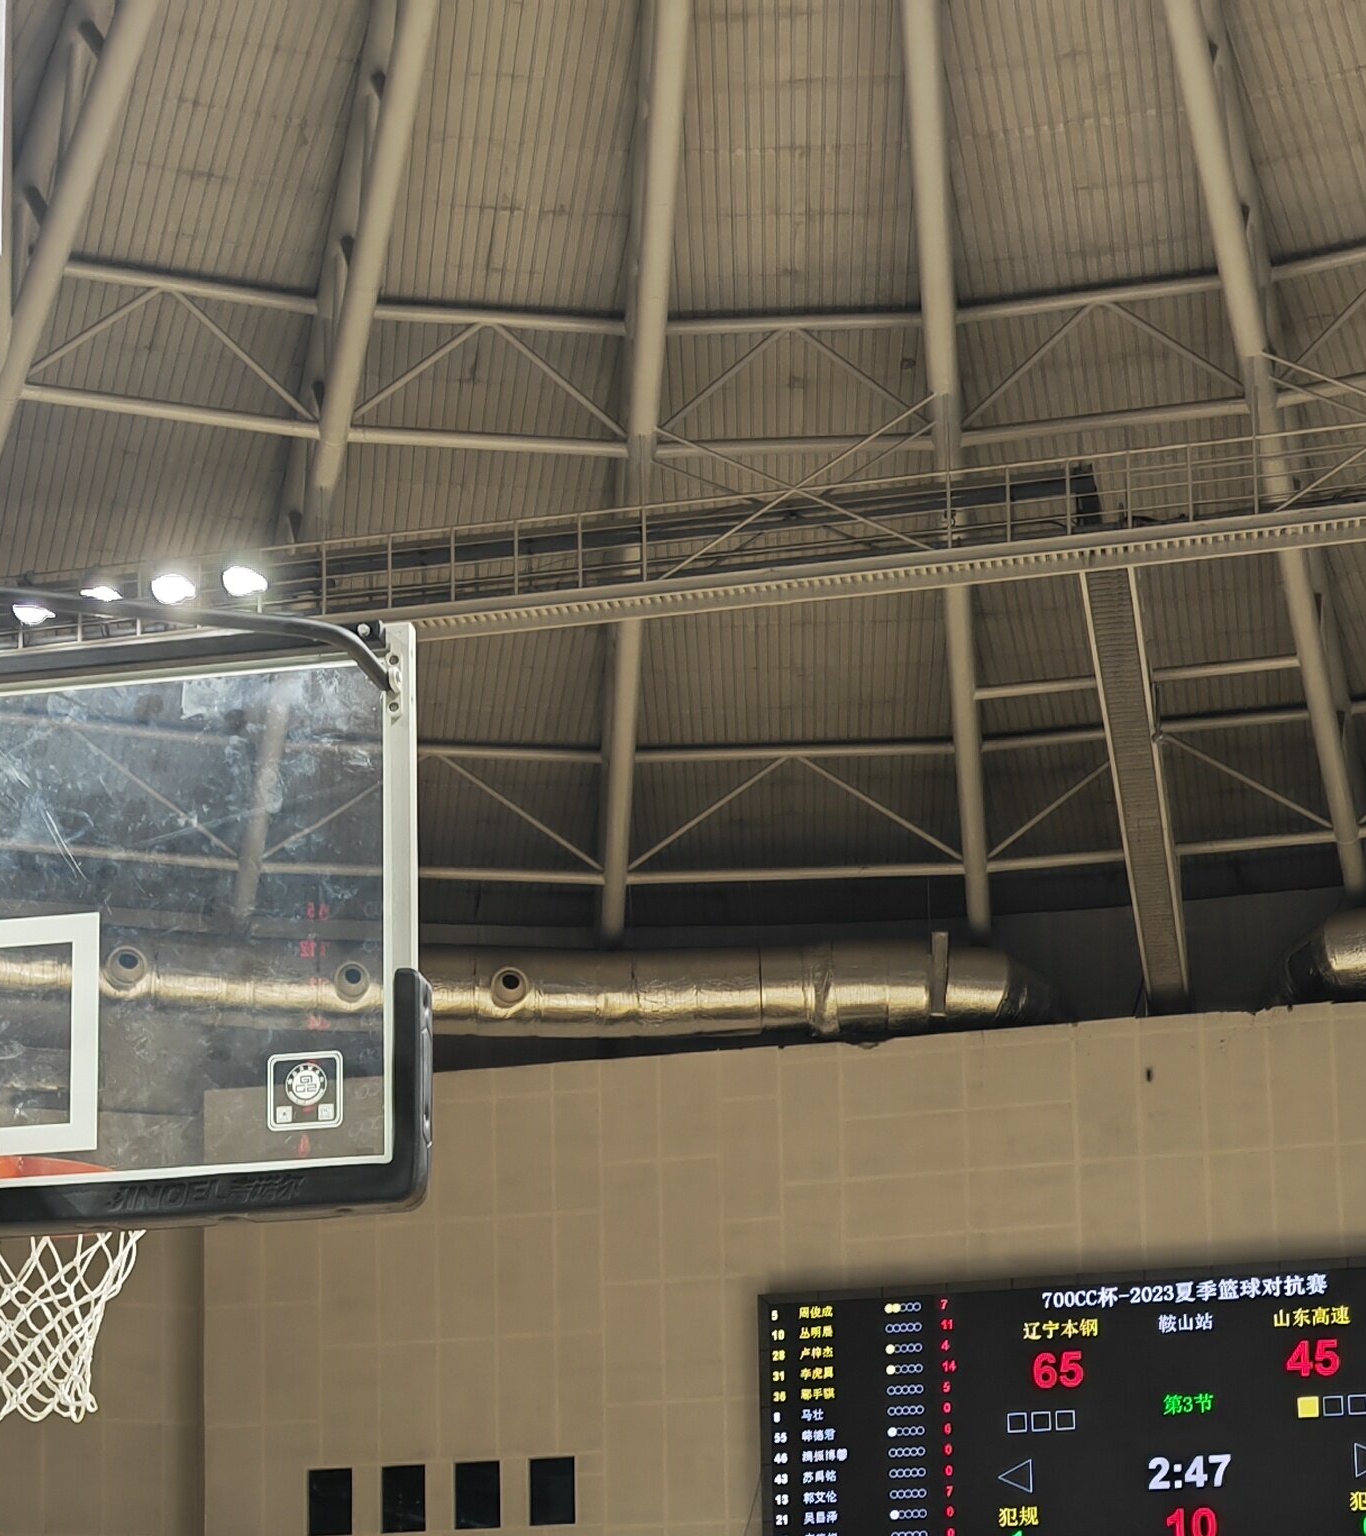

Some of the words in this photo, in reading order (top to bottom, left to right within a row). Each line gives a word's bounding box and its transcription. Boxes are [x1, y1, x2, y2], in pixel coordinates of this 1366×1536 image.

[1042, 1273, 1327, 1309] 700CC杯-2023夏季篮球对抗赛
[771, 1310, 778, 1321] 5
[1157, 1312, 1214, 1334] 鞍山站
[1273, 1305, 1351, 1328] 山东高速
[771, 1329, 785, 1341] 10
[1023, 1318, 1098, 1341] 辽宁本钢
[1285, 1339, 1341, 1377] 45
[773, 1370, 785, 1382] 31
[1033, 1351, 1085, 1389] 65
[1163, 1393, 1214, 1416] 第3节
[1148, 1454, 1231, 1490] 2:47
[775, 1514, 789, 1526] 21
[998, 1506, 1039, 1527] 犯规
